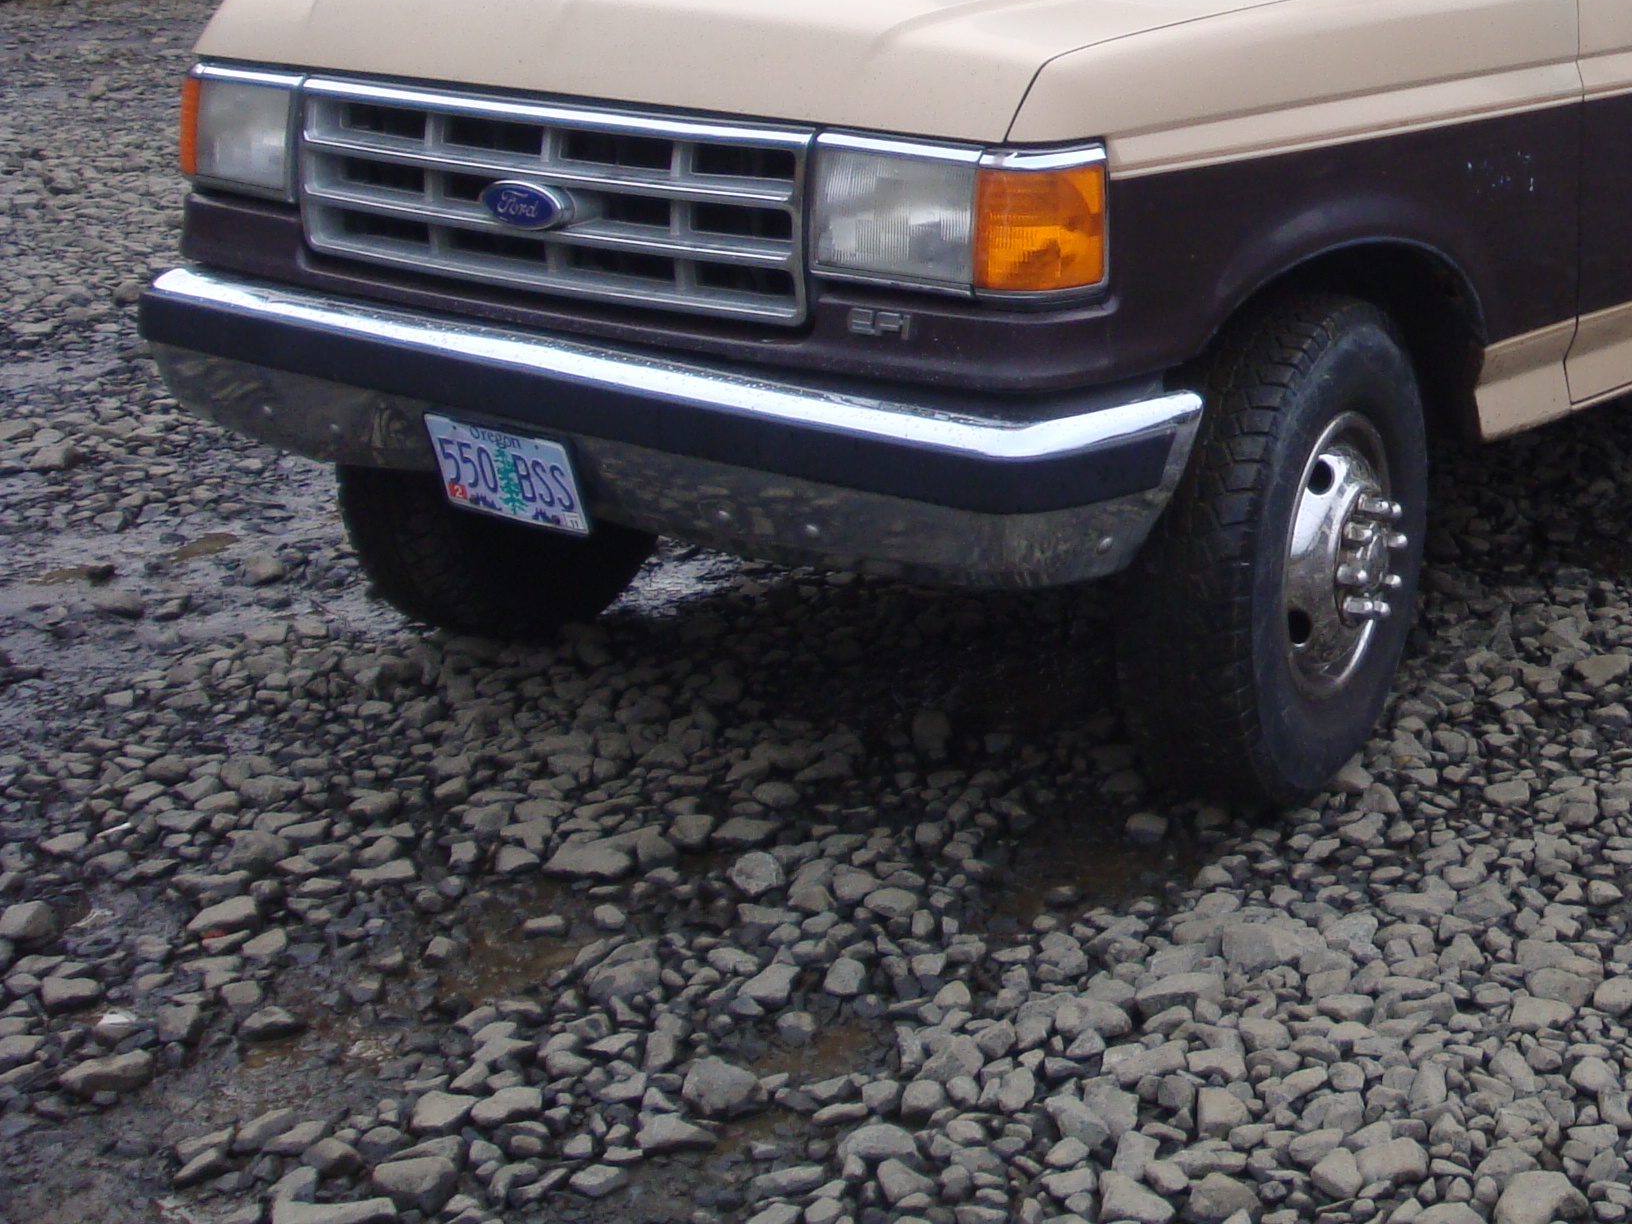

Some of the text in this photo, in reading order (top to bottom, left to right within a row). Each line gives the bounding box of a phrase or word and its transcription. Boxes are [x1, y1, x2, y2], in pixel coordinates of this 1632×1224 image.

[496, 189, 539, 218] Ford
[469, 424, 523, 450] Oregon
[438, 437, 575, 512] 550 BSS
[453, 485, 464, 498] 2
